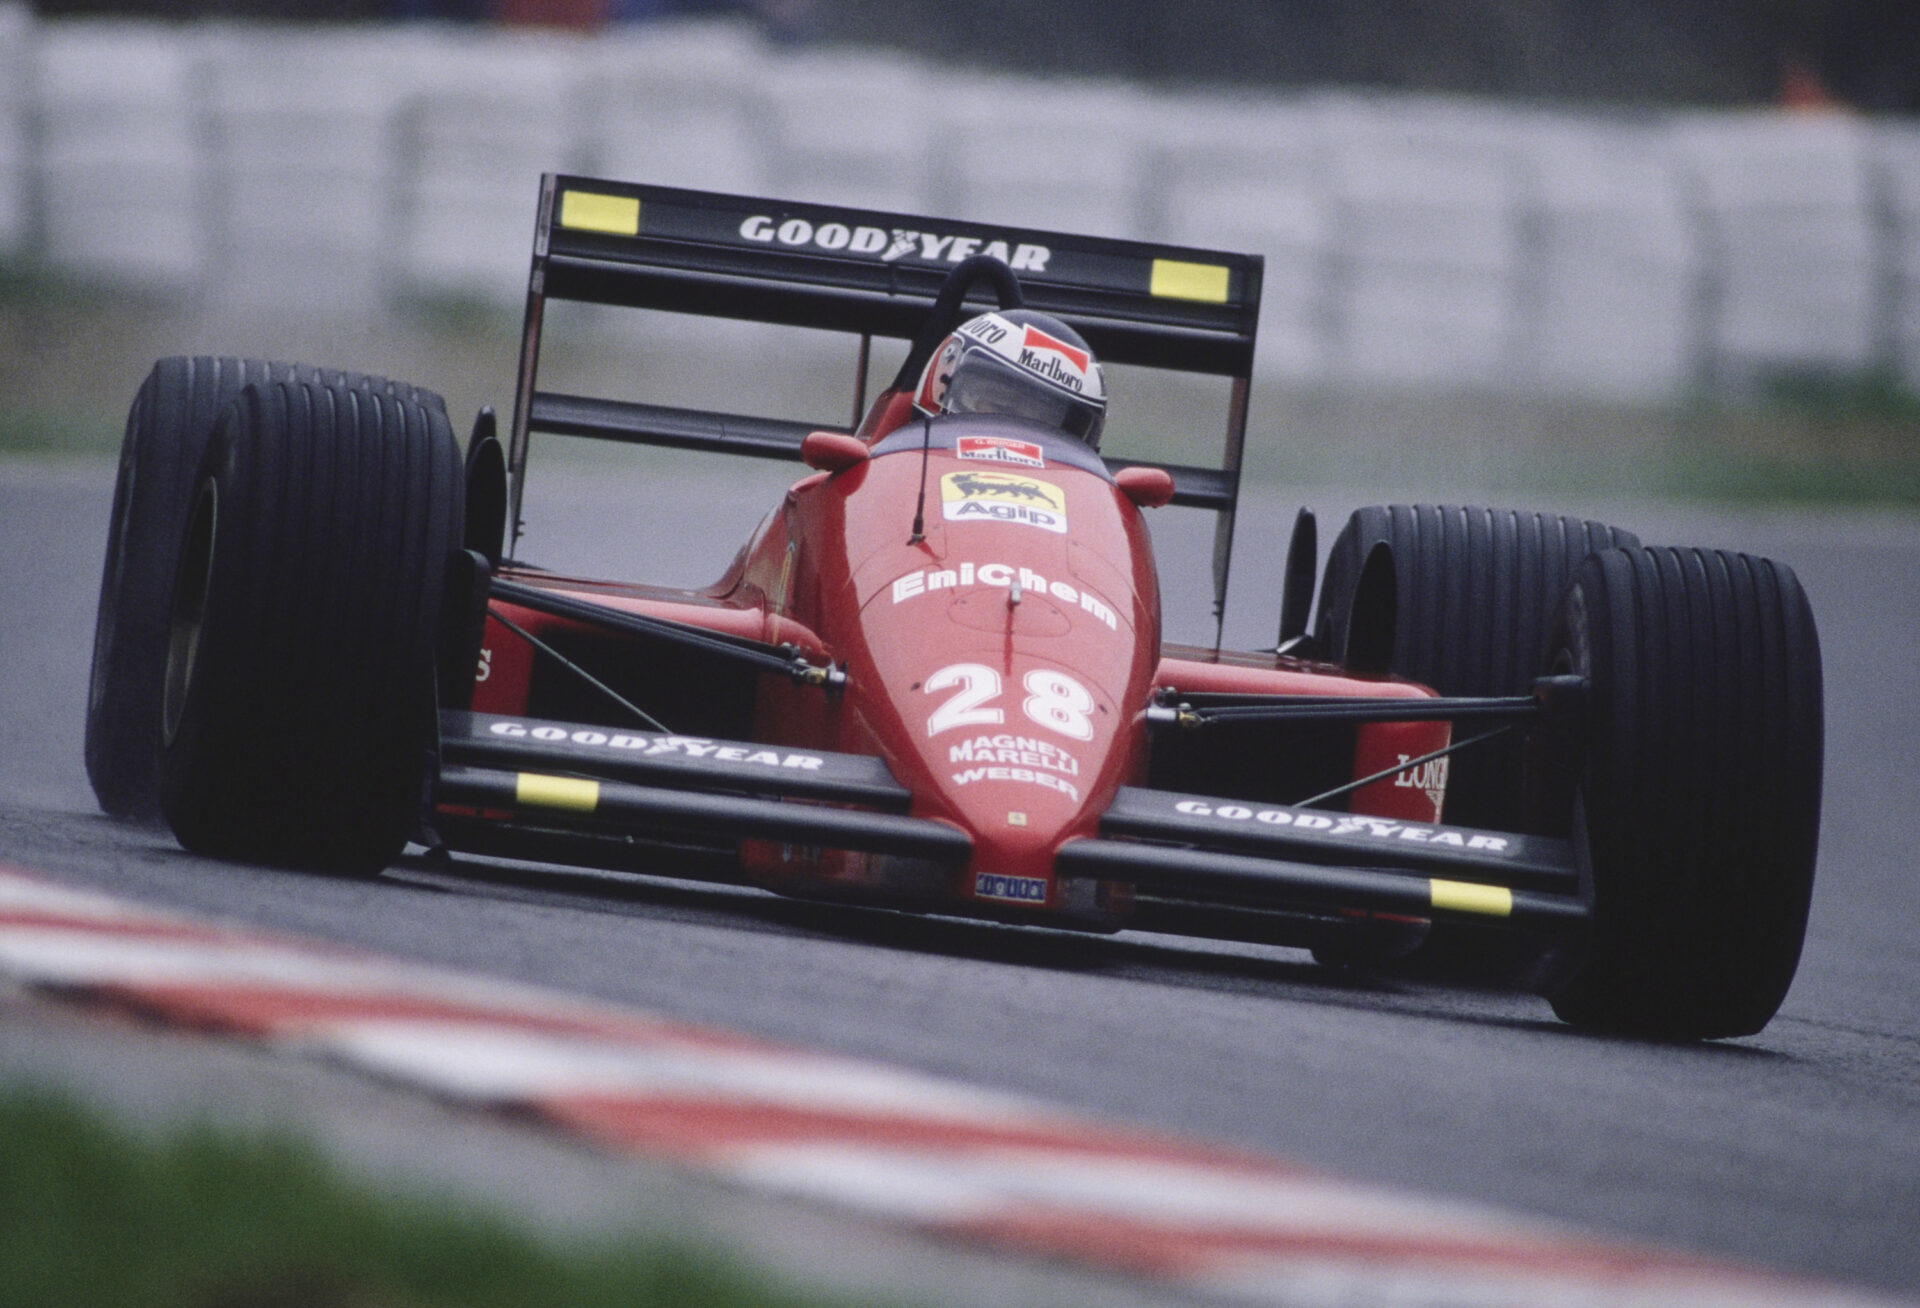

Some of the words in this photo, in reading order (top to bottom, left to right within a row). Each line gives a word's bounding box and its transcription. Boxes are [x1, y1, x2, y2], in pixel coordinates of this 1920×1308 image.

[739, 215, 1051, 272] GOODYEAR
[1018, 348, 1083, 392] Marlboro
[960, 449, 1042, 467] Marlboro
[956, 501, 1056, 525] Agip
[892, 562, 1117, 631] EniChem
[924, 663, 1095, 741] 28
[490, 722, 824, 770] GOODYEAR
[949, 734, 1079, 772] MAGNETI
[949, 741, 1079, 776] MARELLI
[951, 766, 1079, 802] WEBER
[1175, 800, 1508, 851] GOODYEAR
